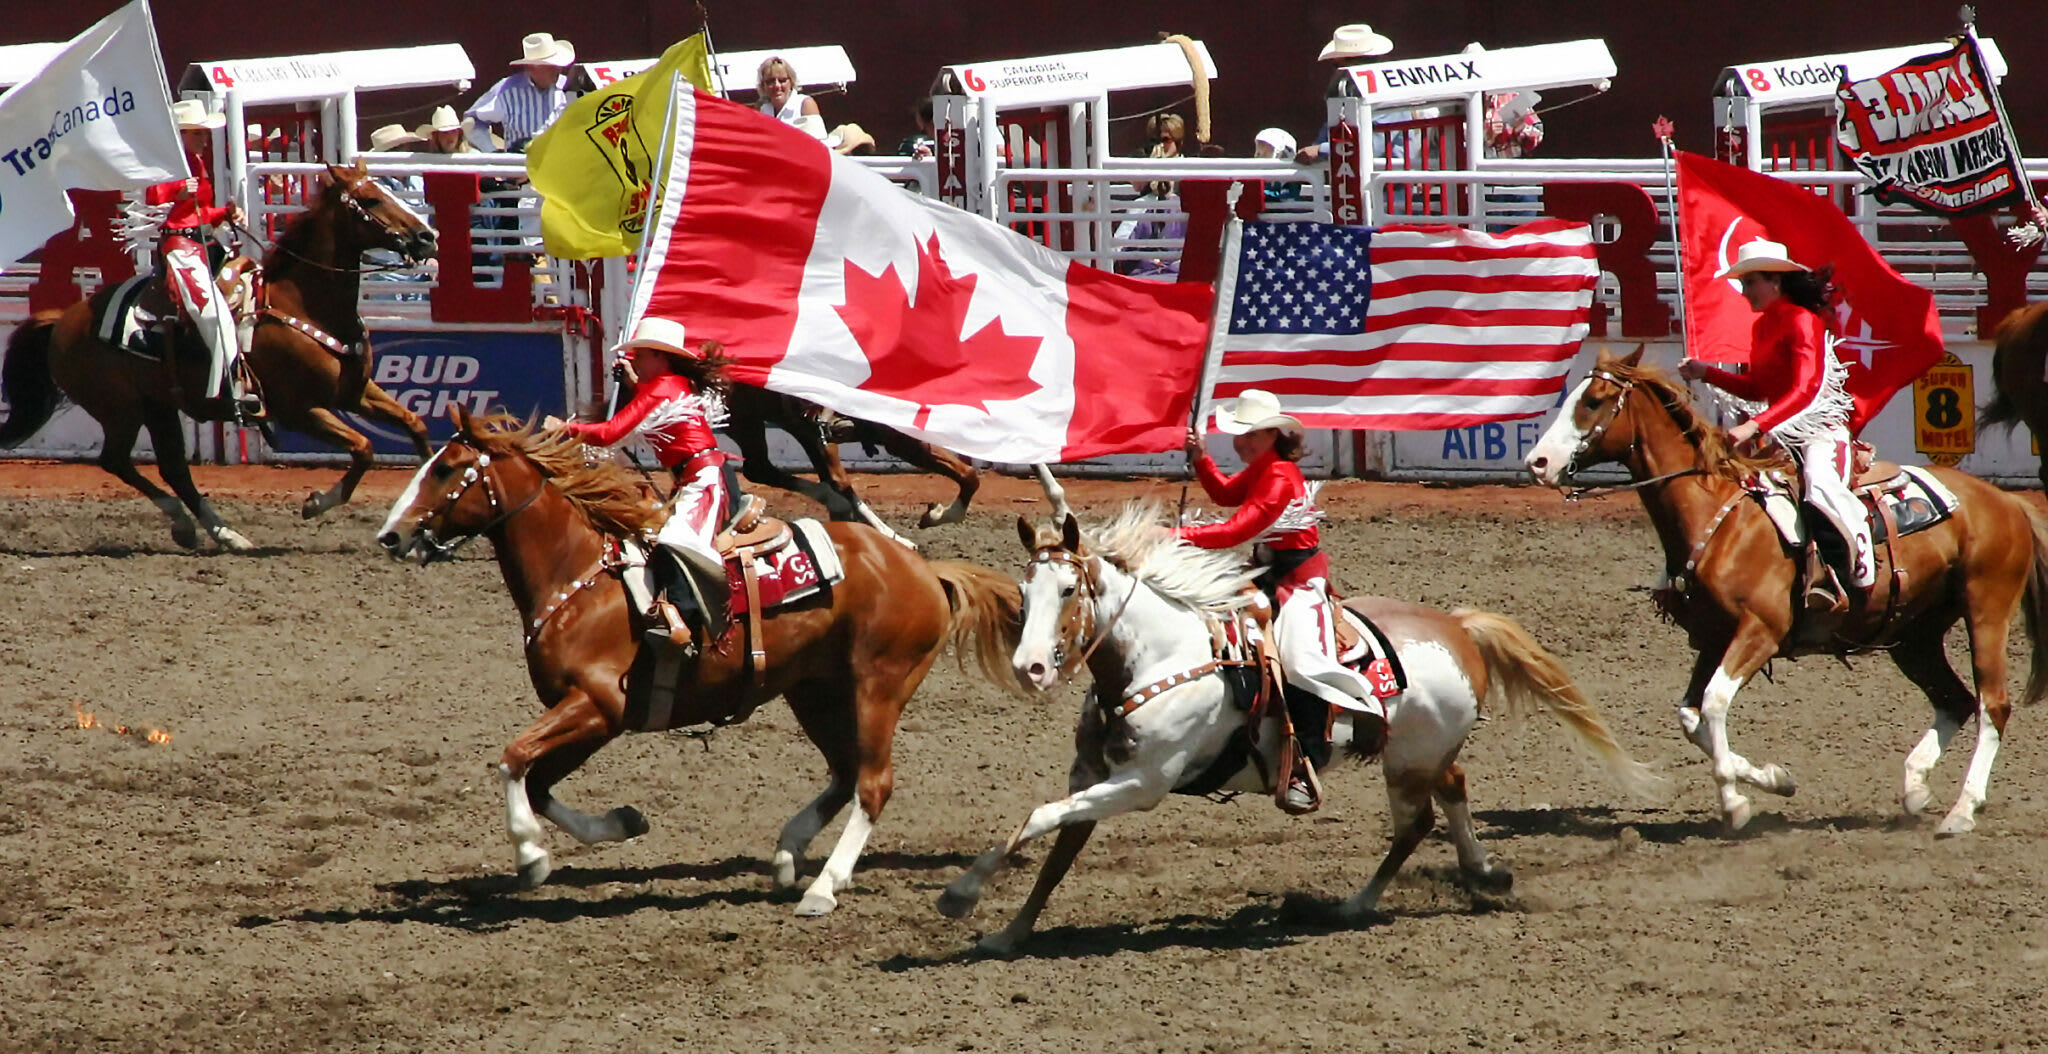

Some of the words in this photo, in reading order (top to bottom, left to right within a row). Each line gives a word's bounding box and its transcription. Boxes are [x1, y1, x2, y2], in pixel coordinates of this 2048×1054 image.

[212, 66, 235, 88] 4
[594, 67, 617, 88] 5
[964, 68, 986, 92] 6
[989, 75, 1045, 89] SUPERIOR
[1046, 71, 1089, 84] ENERGY
[1003, 62, 1066, 76] CANADIAN
[1381, 61, 1482, 88] ENMAX
[1746, 68, 1771, 91] 8
[1773, 62, 1843, 87] Kodak
[1356, 69, 1378, 94] 7
[375, 355, 480, 384] BUD
[1920, 372, 1967, 390] SUPER
[385, 389, 499, 418] GHT
[1925, 387, 1963, 429] 8
[1442, 422, 1507, 460] ATB
[1921, 428, 1970, 449] MOTEL
